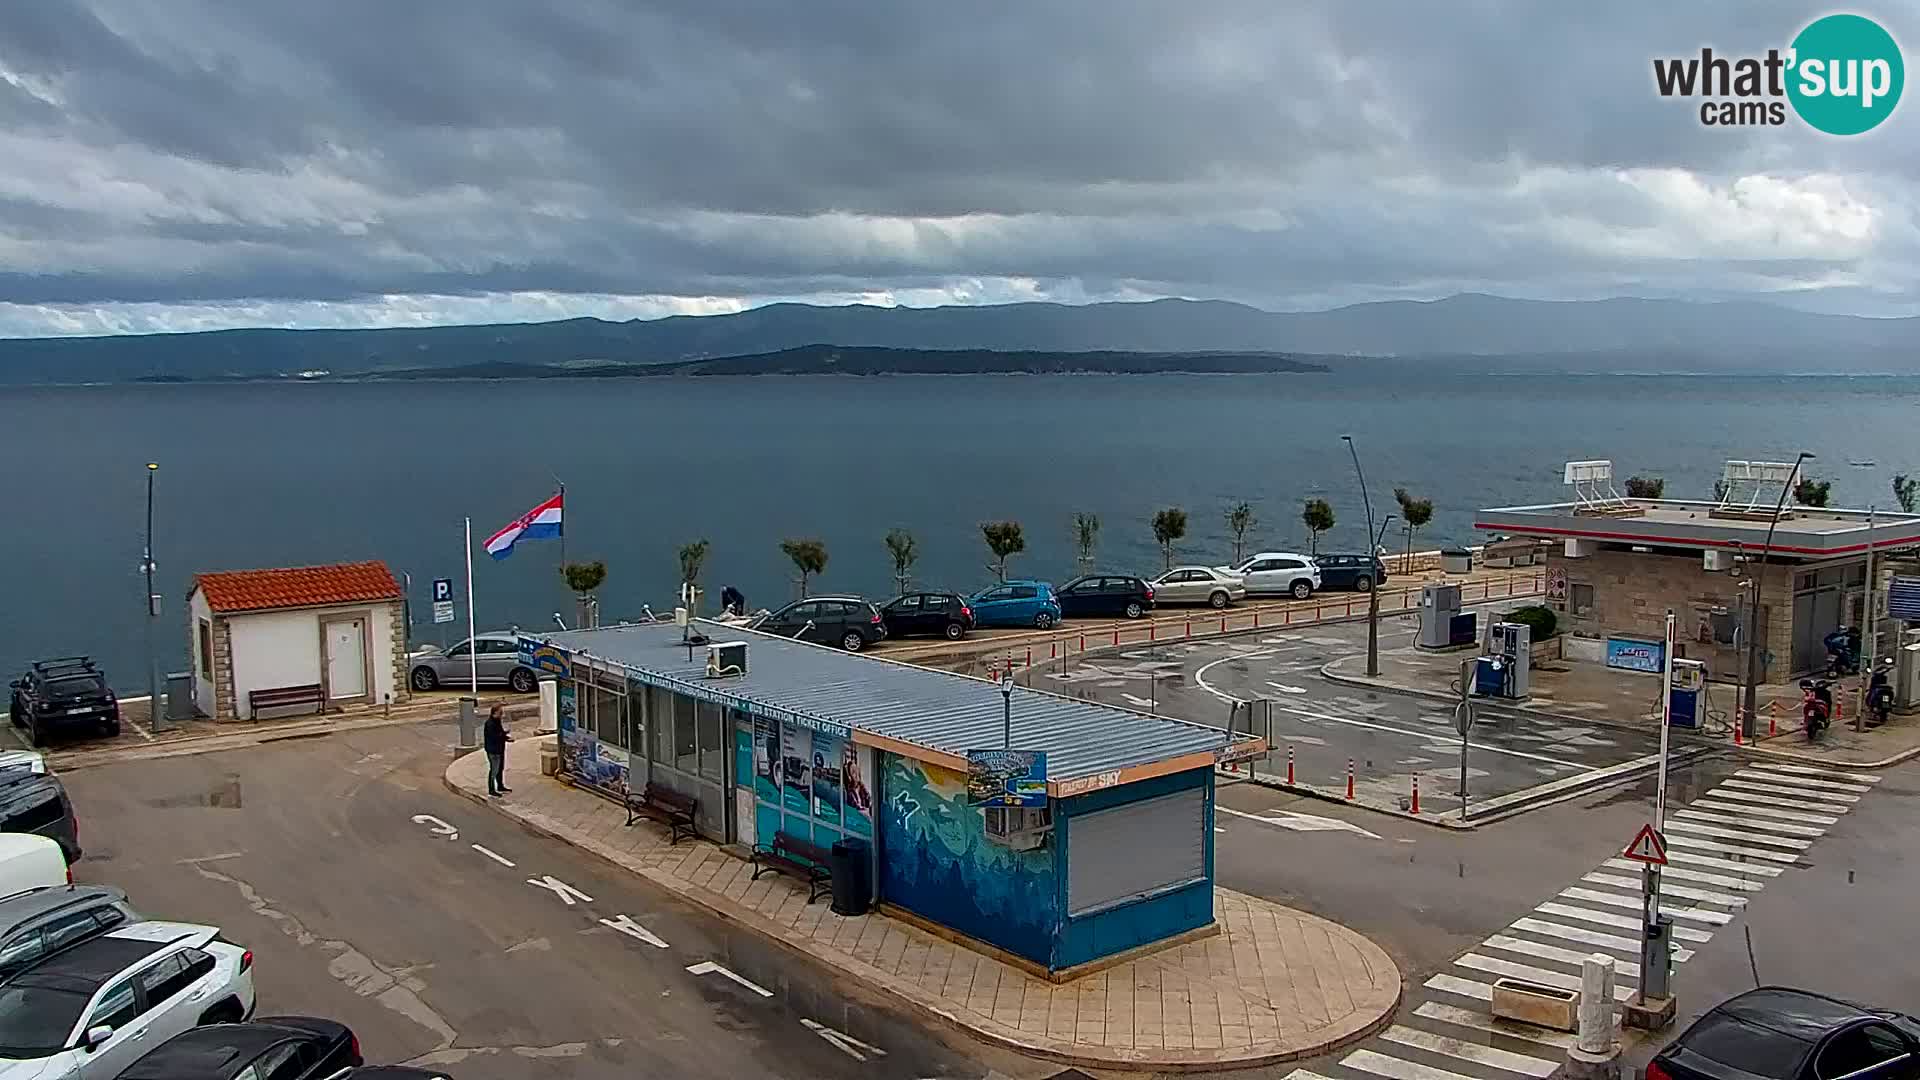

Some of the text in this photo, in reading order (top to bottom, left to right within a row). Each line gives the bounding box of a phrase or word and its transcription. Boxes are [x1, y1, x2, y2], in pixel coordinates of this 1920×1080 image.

[437, 582, 448, 599] P
[748, 702, 762, 715] BUS
[764, 706, 794, 723] STATION
[796, 715, 821, 731] TICKET
[822, 722, 848, 737] OFFICE
